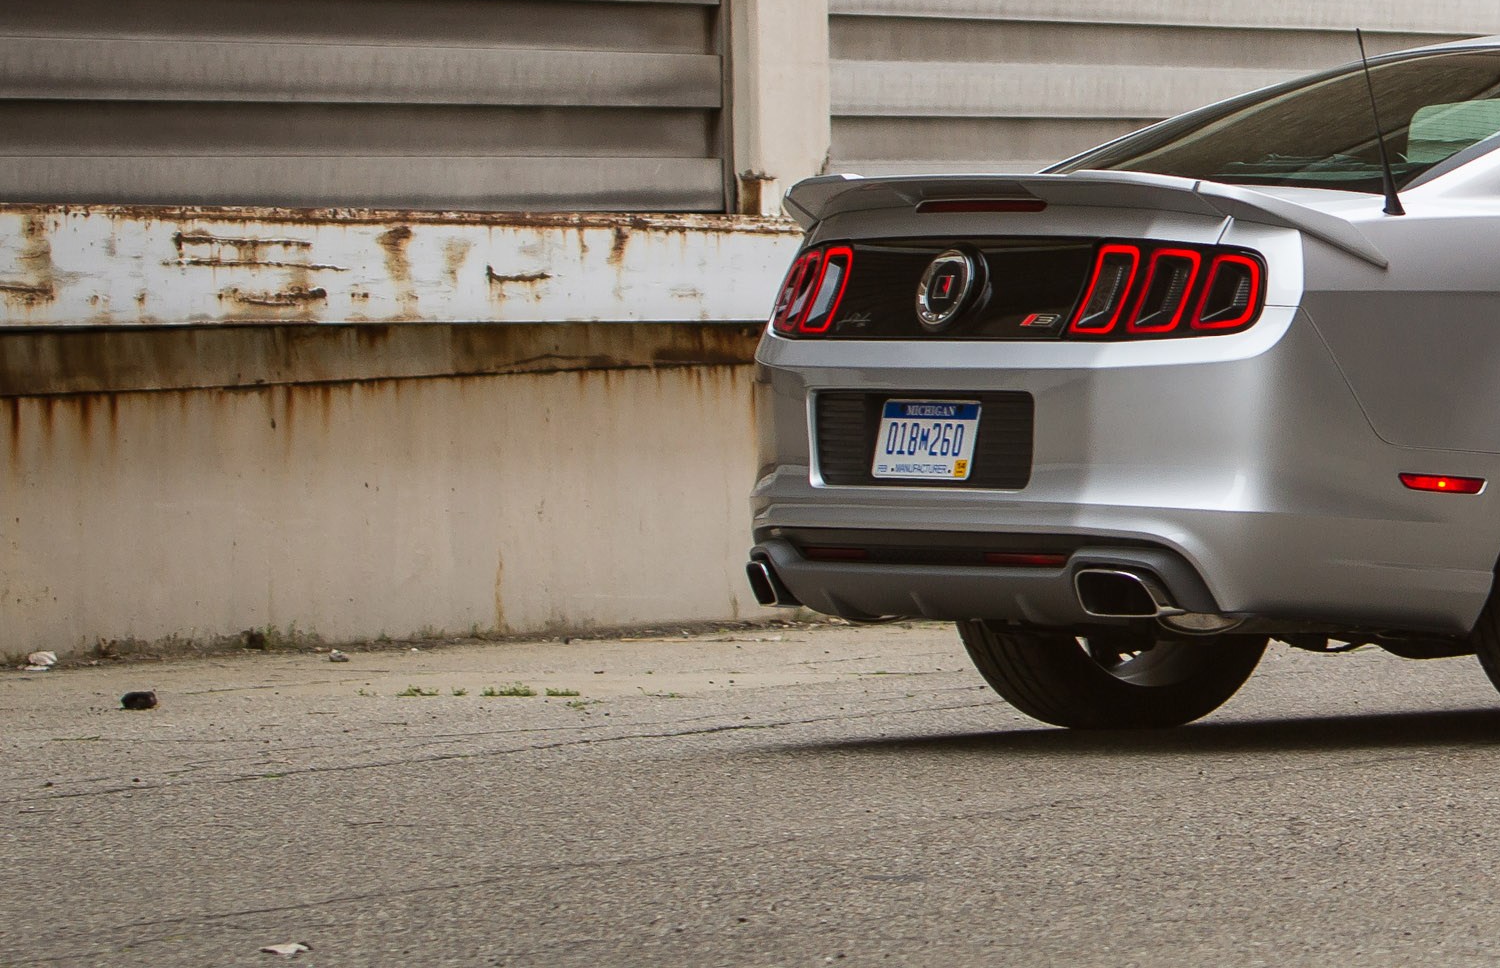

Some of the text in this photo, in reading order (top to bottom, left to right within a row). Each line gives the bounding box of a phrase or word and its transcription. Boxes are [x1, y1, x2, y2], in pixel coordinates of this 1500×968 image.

[906, 404, 957, 416] MICHIGAN
[886, 421, 965, 457] 018M260
[895, 463, 947, 474] MANUFACTURER
